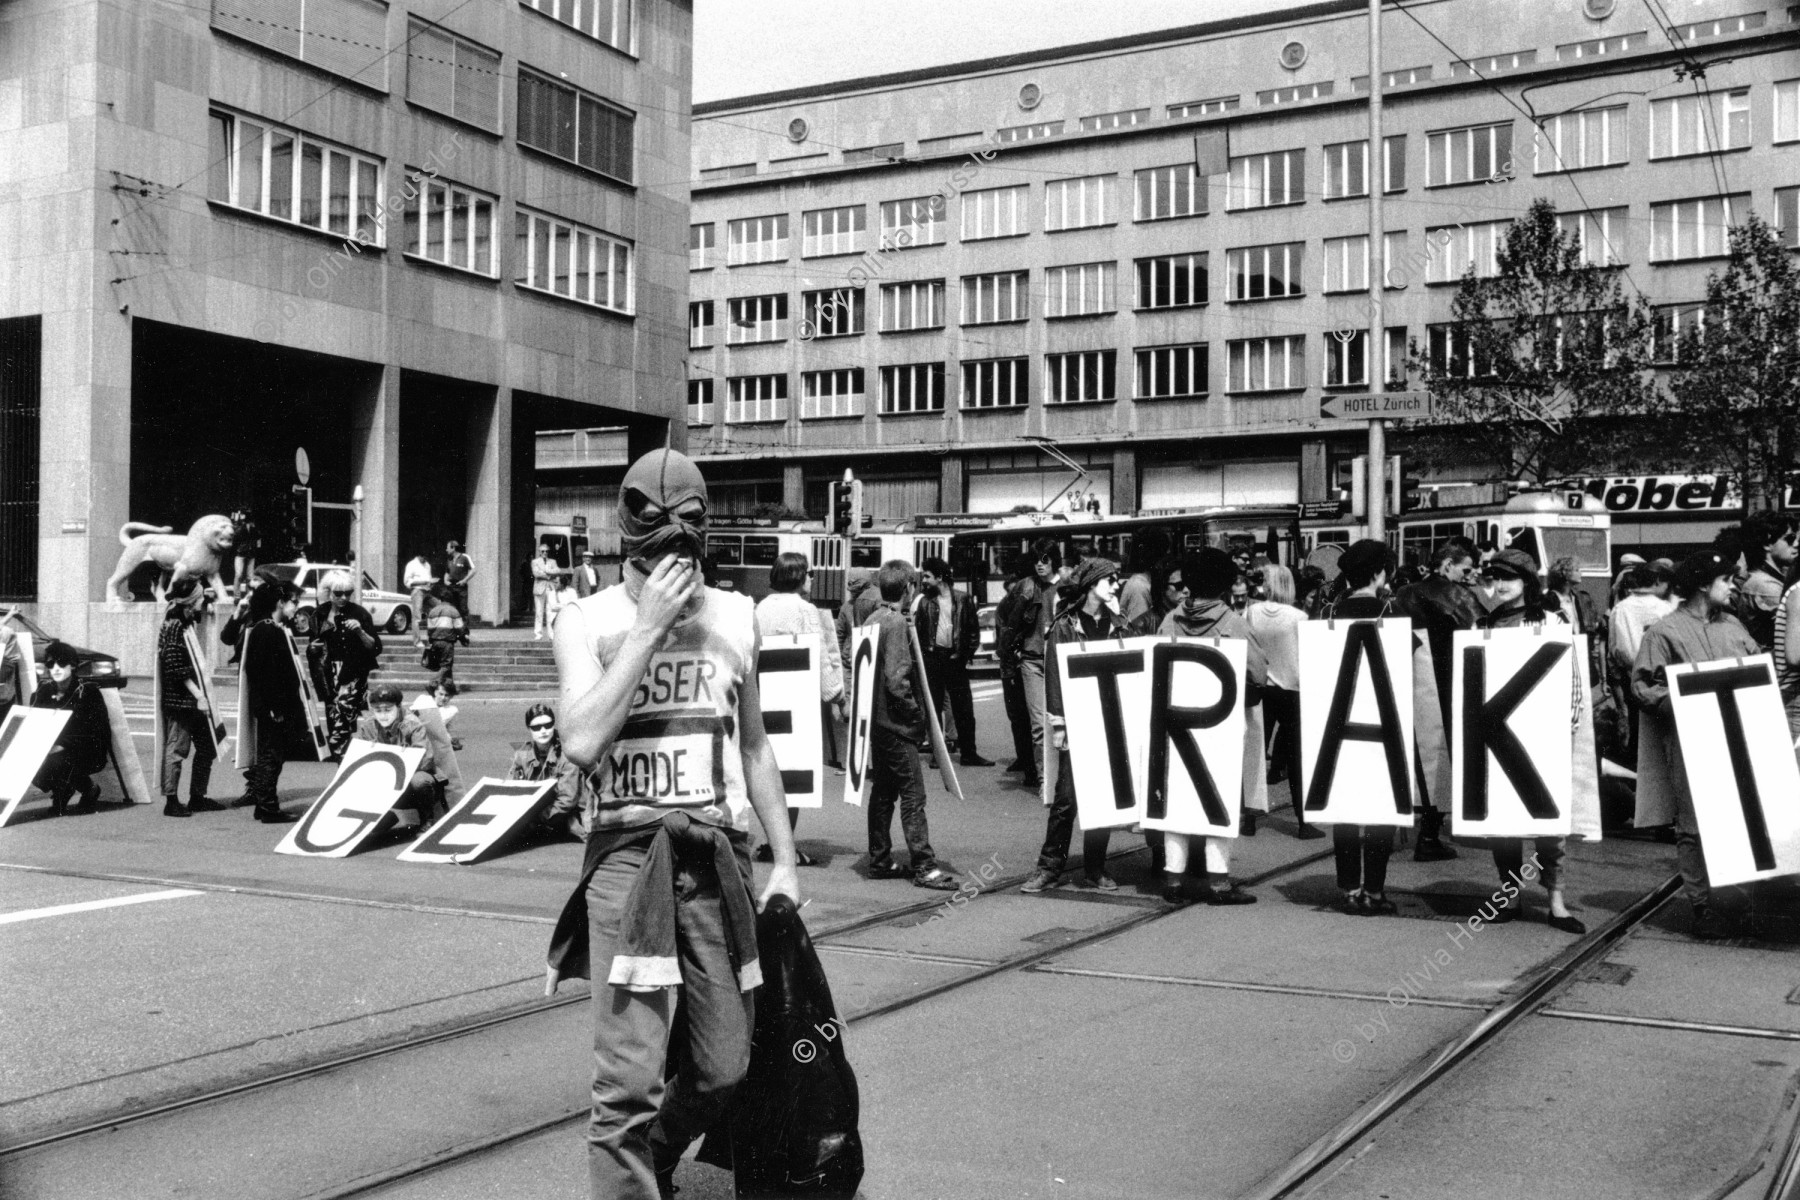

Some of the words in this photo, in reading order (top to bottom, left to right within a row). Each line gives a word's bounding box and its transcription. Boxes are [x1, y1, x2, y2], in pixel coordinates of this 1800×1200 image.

[1344, 398, 1379, 412] HOTEL
[1571, 496, 1579, 507] 7
[1298, 503, 1304, 518] 7
